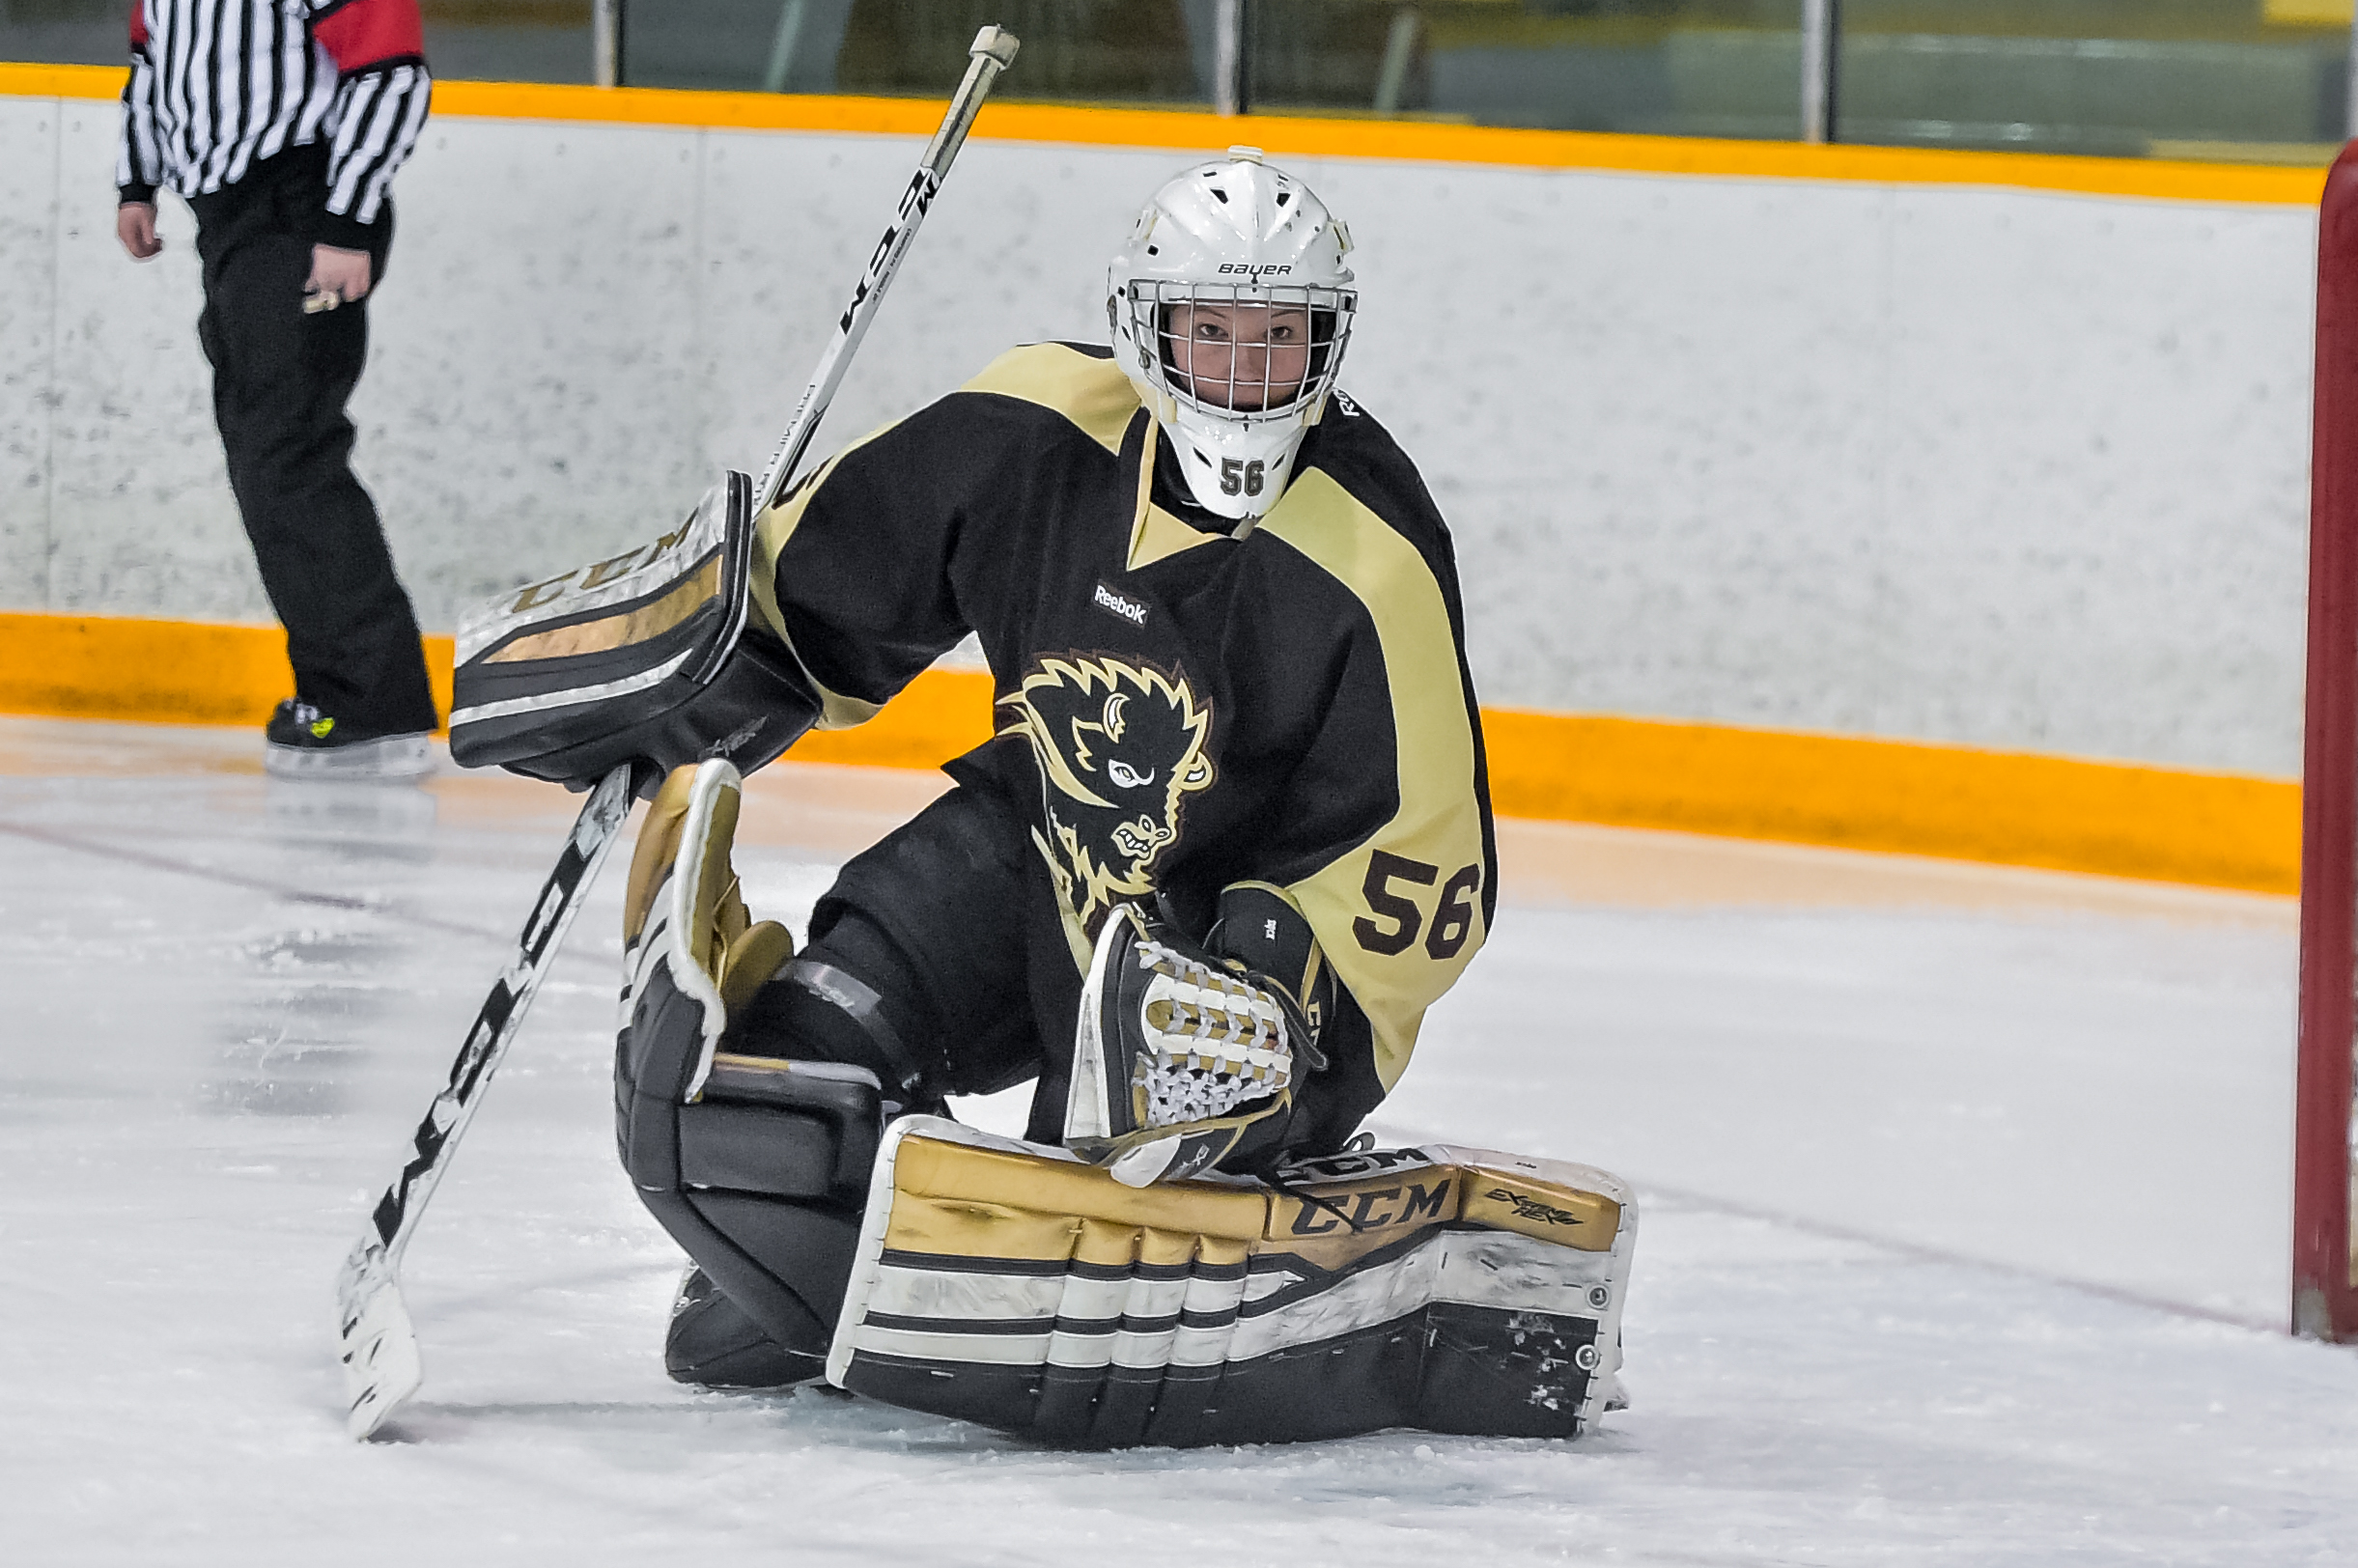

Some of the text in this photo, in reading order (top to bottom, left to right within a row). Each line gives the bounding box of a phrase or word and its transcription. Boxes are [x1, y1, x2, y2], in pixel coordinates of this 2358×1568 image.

[840, 168, 928, 334] CCM
[1221, 457, 1264, 496] 56
[1094, 584, 1147, 625] Reebok
[1352, 848, 1480, 961] 56
[373, 839, 601, 1247] CCM
[1291, 1178, 1452, 1235] CCM
